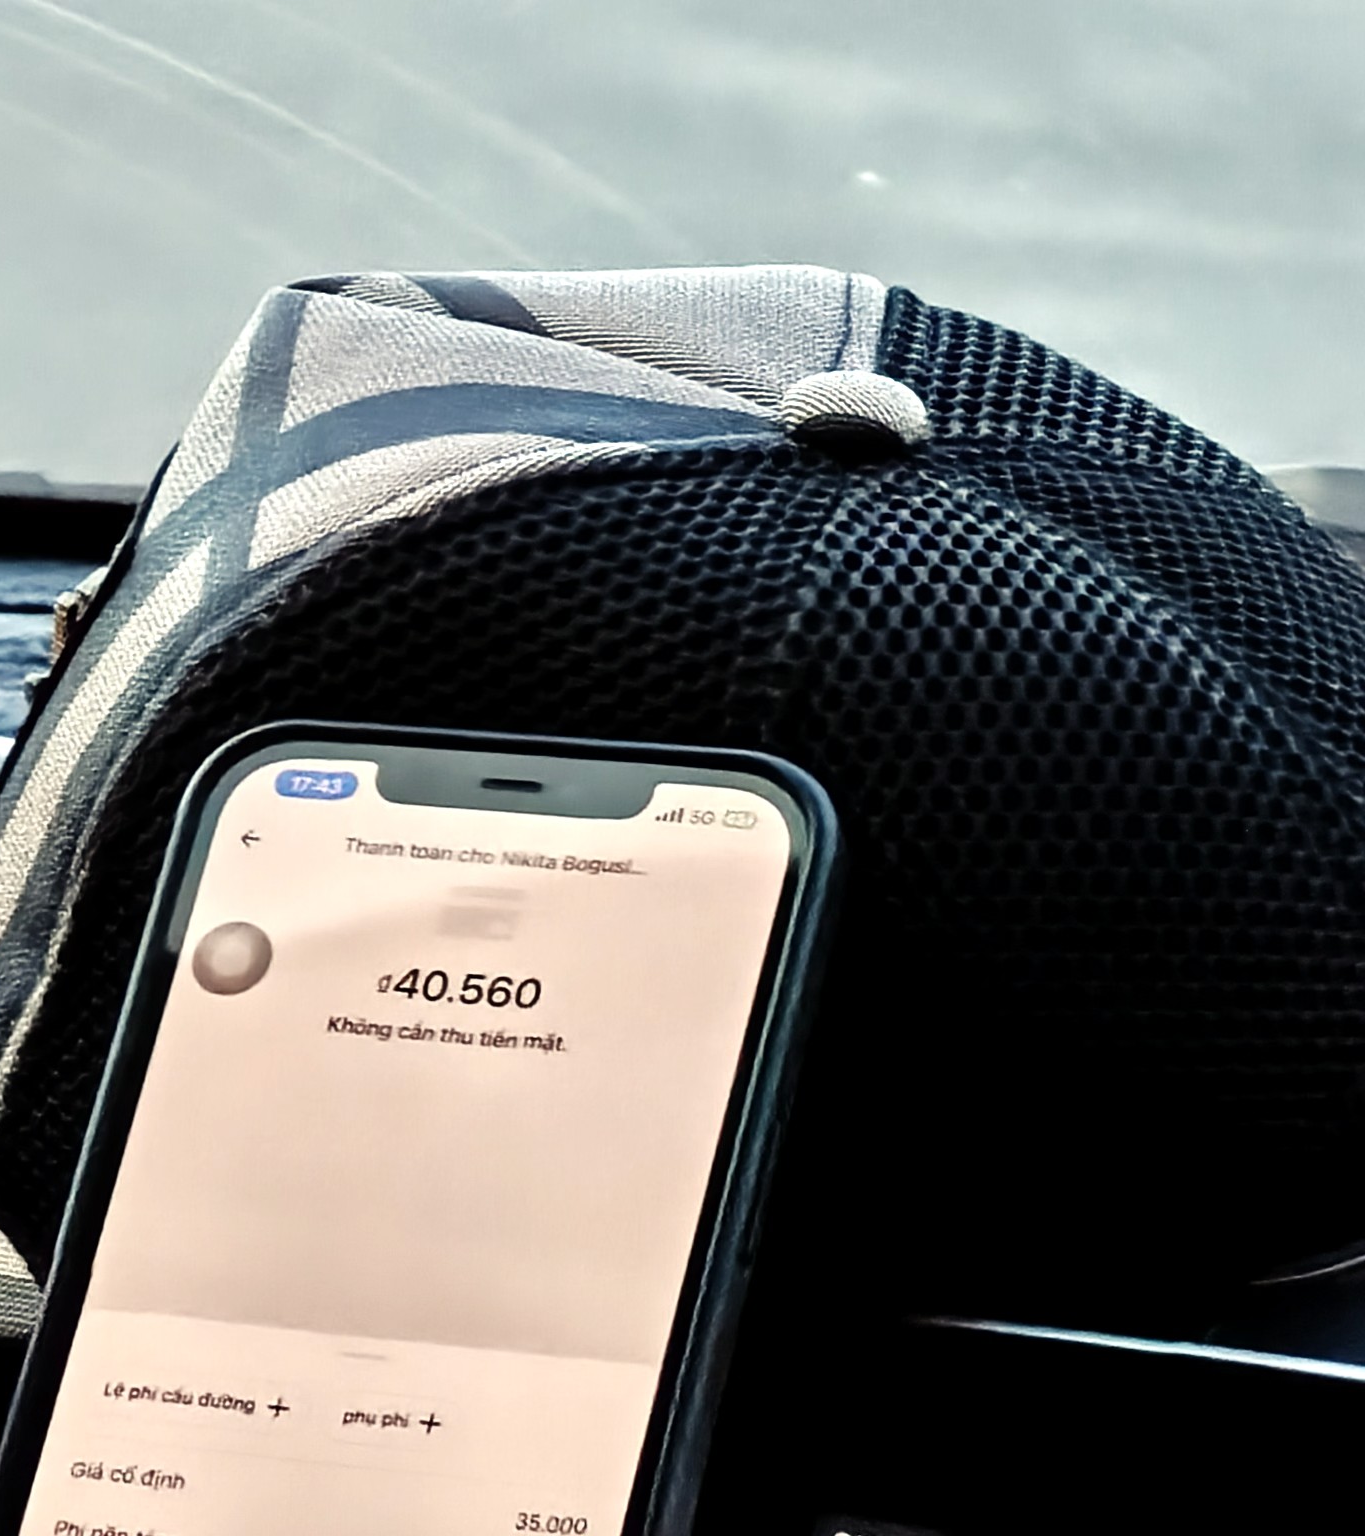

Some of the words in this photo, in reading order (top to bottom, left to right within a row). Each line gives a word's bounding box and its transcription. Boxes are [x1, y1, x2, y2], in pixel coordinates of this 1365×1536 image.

[501, 851, 557, 870] Nikita
[439, 1027, 473, 1045] thu
[140, 1468, 186, 1492] định
[514, 1511, 589, 1535] 35.000
